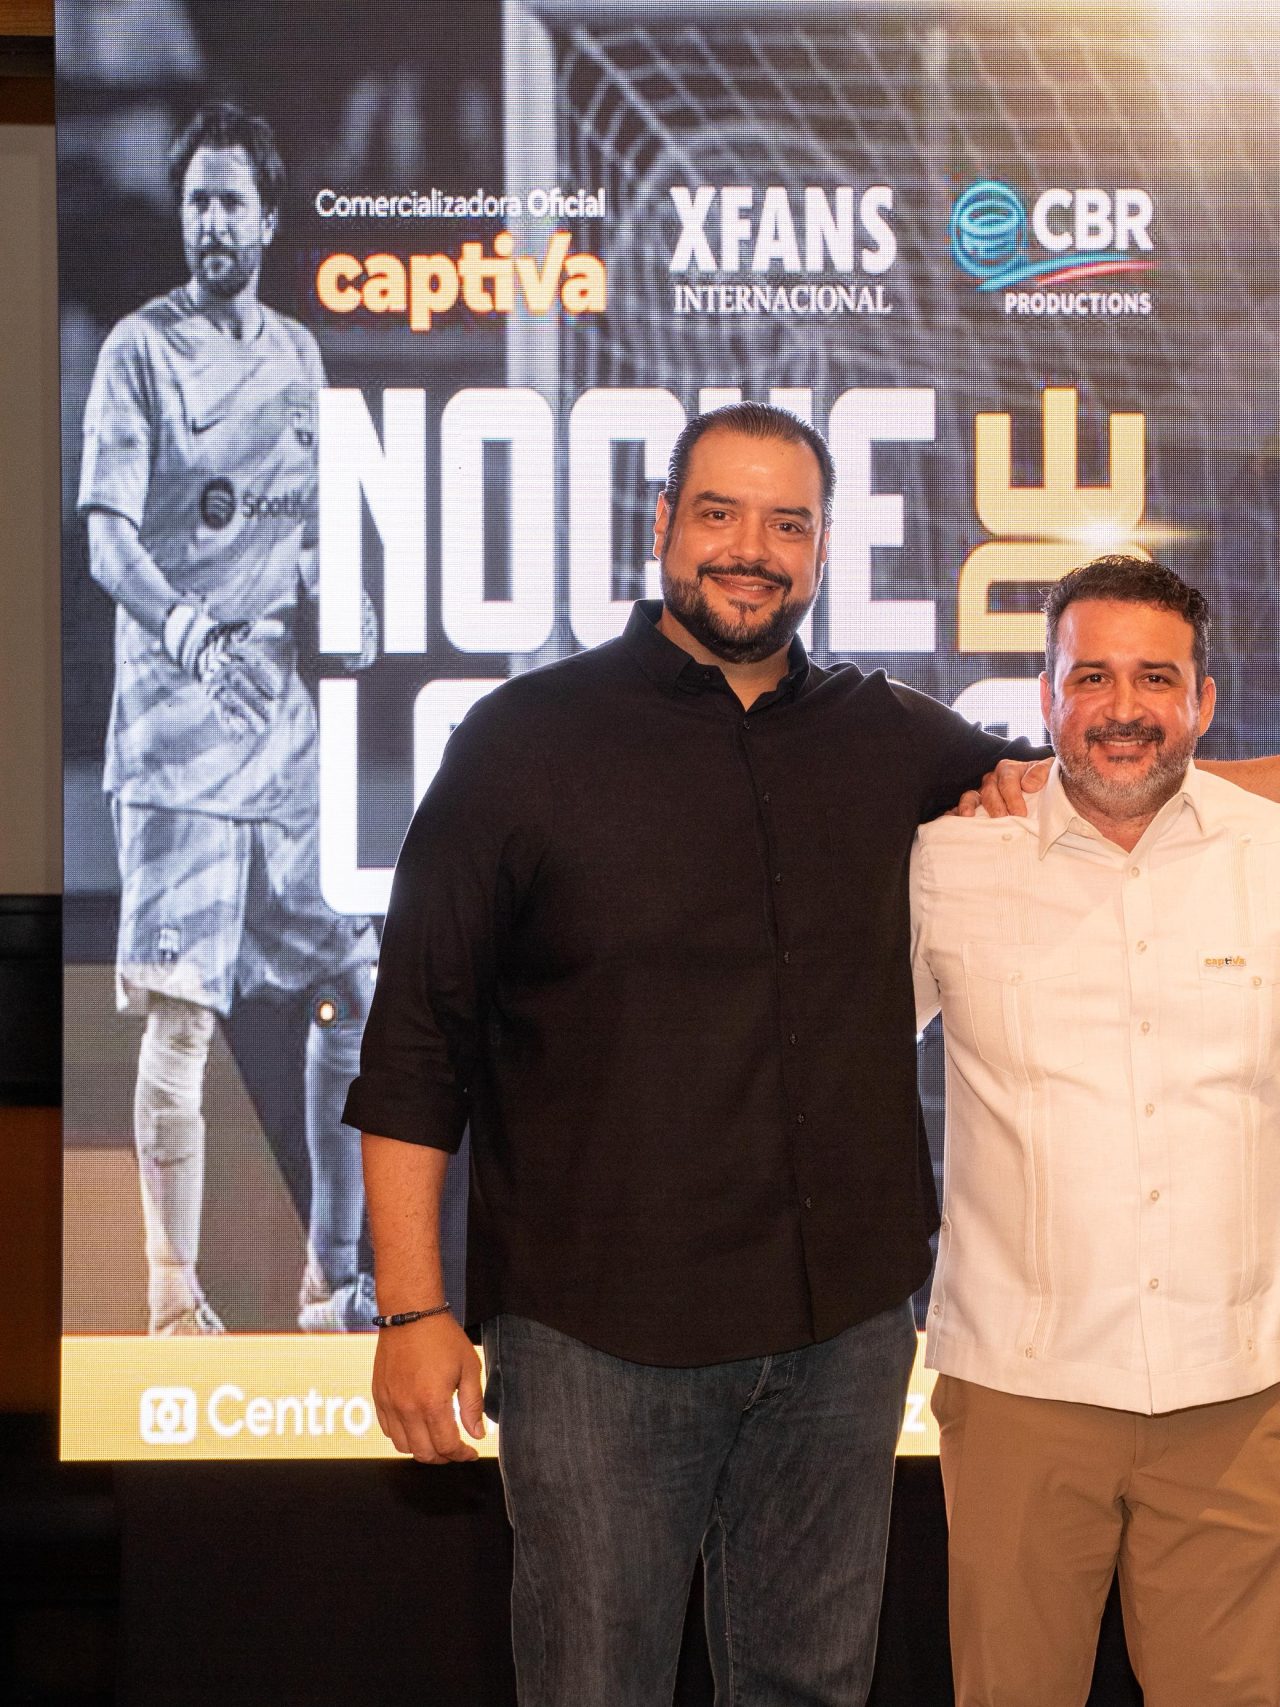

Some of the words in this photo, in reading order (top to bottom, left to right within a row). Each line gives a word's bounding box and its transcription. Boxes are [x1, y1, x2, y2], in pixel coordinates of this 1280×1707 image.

[315, 188, 519, 217] Comercializadora
[527, 188, 606, 217] Oficial
[668, 185, 898, 275] XFANS
[1032, 187, 1154, 251] CBR
[315, 229, 607, 332] captiva
[673, 284, 893, 313] INTERNACIONAL
[1004, 292, 1152, 315] PRODUCTIONS
[318, 387, 938, 654] NOCE
[207, 1383, 374, 1438] Centro
